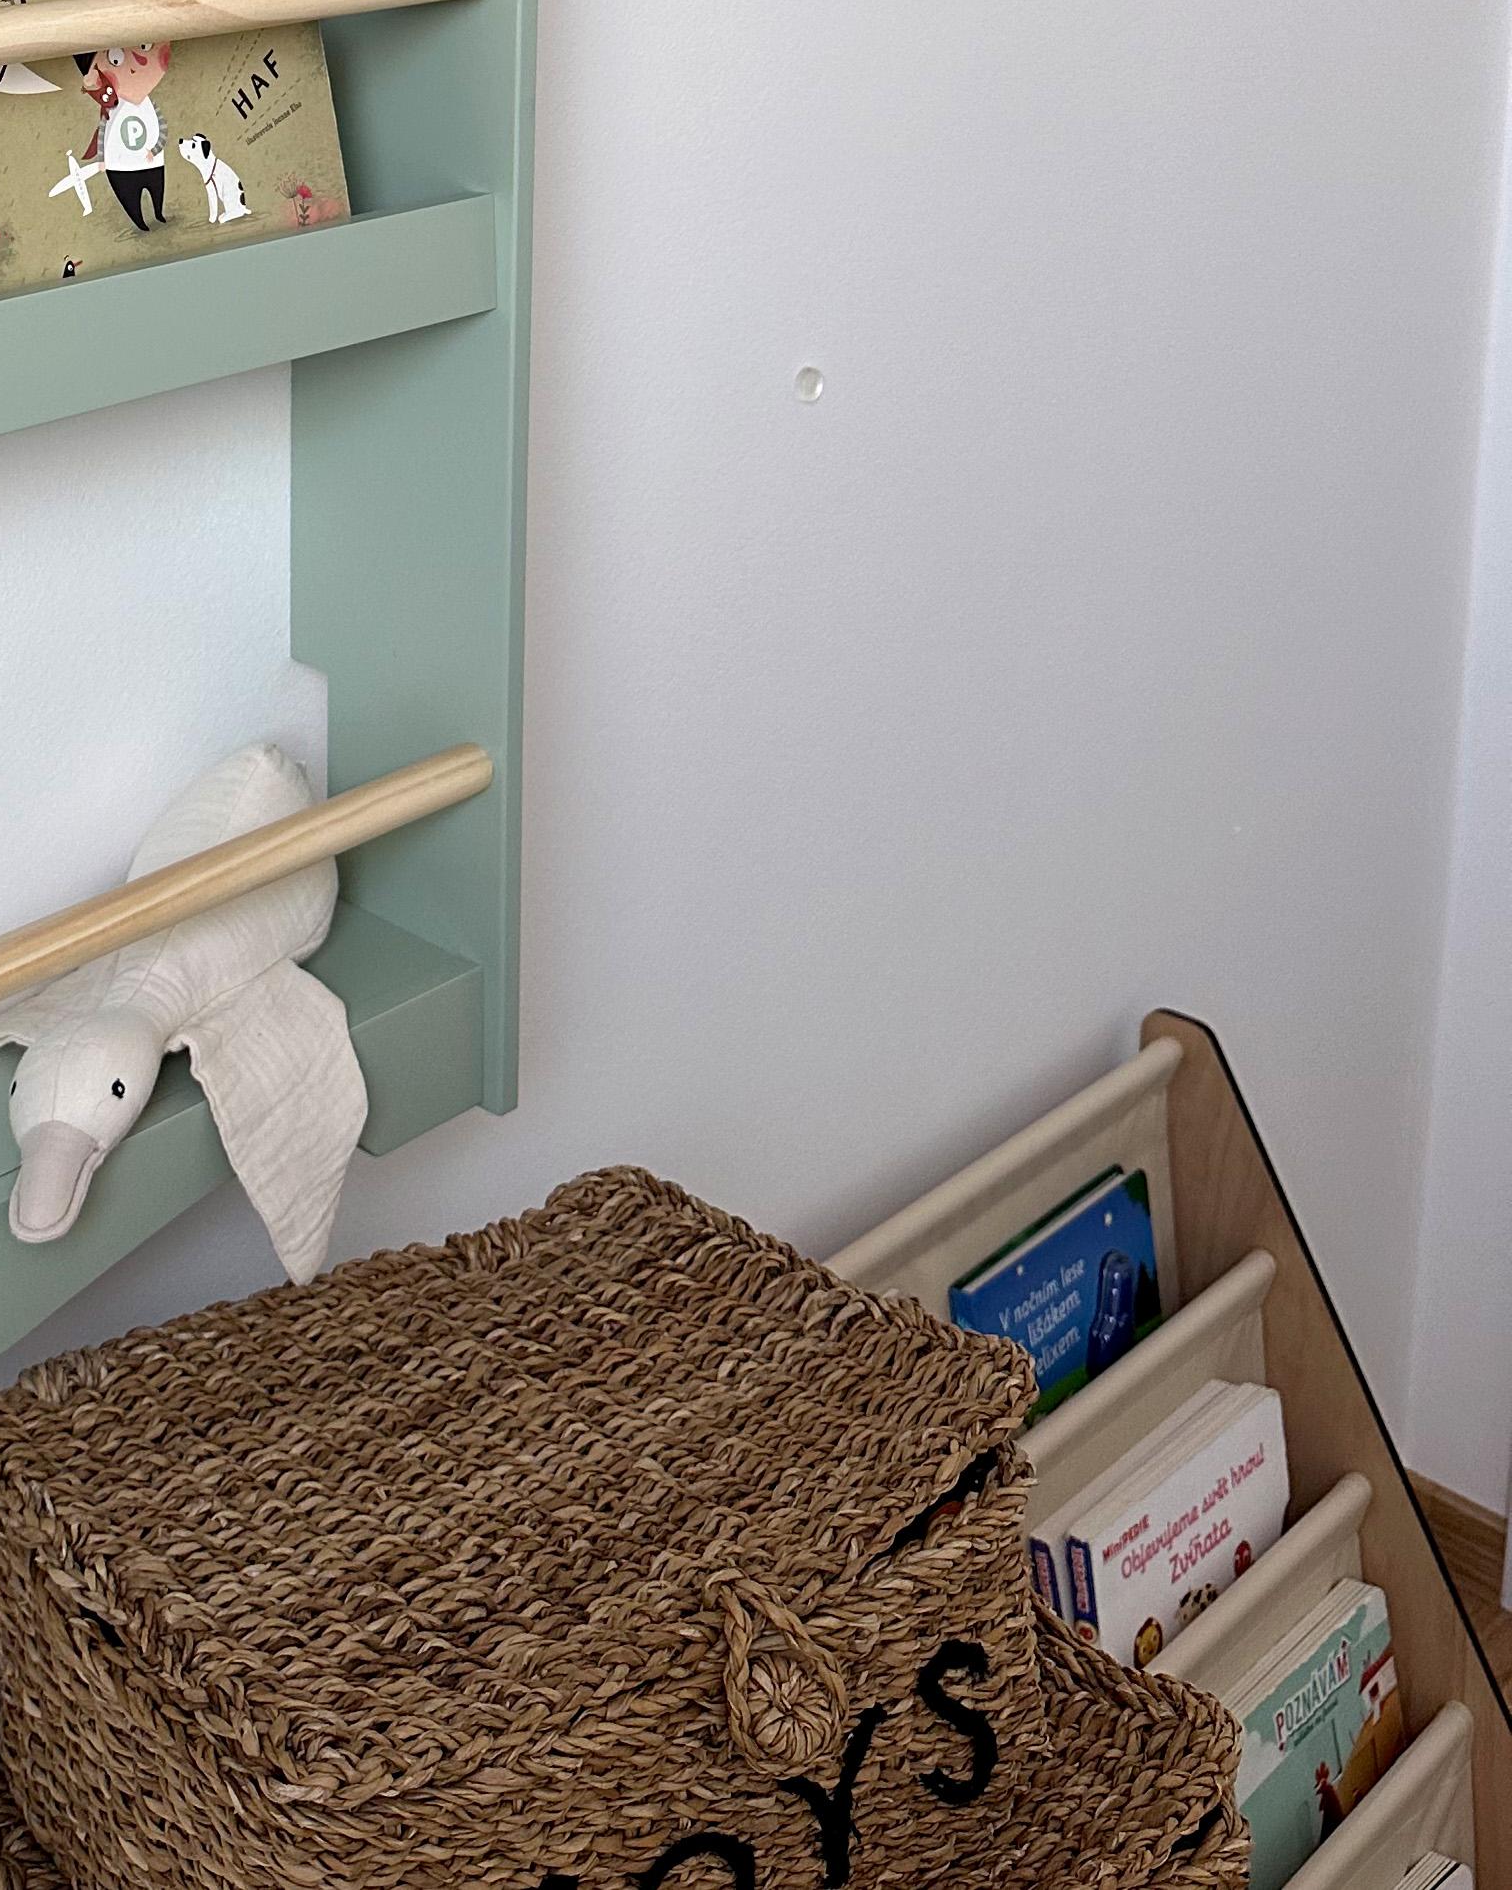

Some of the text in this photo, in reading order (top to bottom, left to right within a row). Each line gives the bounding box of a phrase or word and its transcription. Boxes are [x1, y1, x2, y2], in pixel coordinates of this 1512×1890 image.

[231, 48, 279, 120] HAF
[127, 123, 143, 147] P
[998, 1307, 1011, 1333] V
[1060, 1259, 1087, 1288] lese
[1037, 1325, 1081, 1376] elixem
[1169, 1517, 1233, 1585] Zvířata
